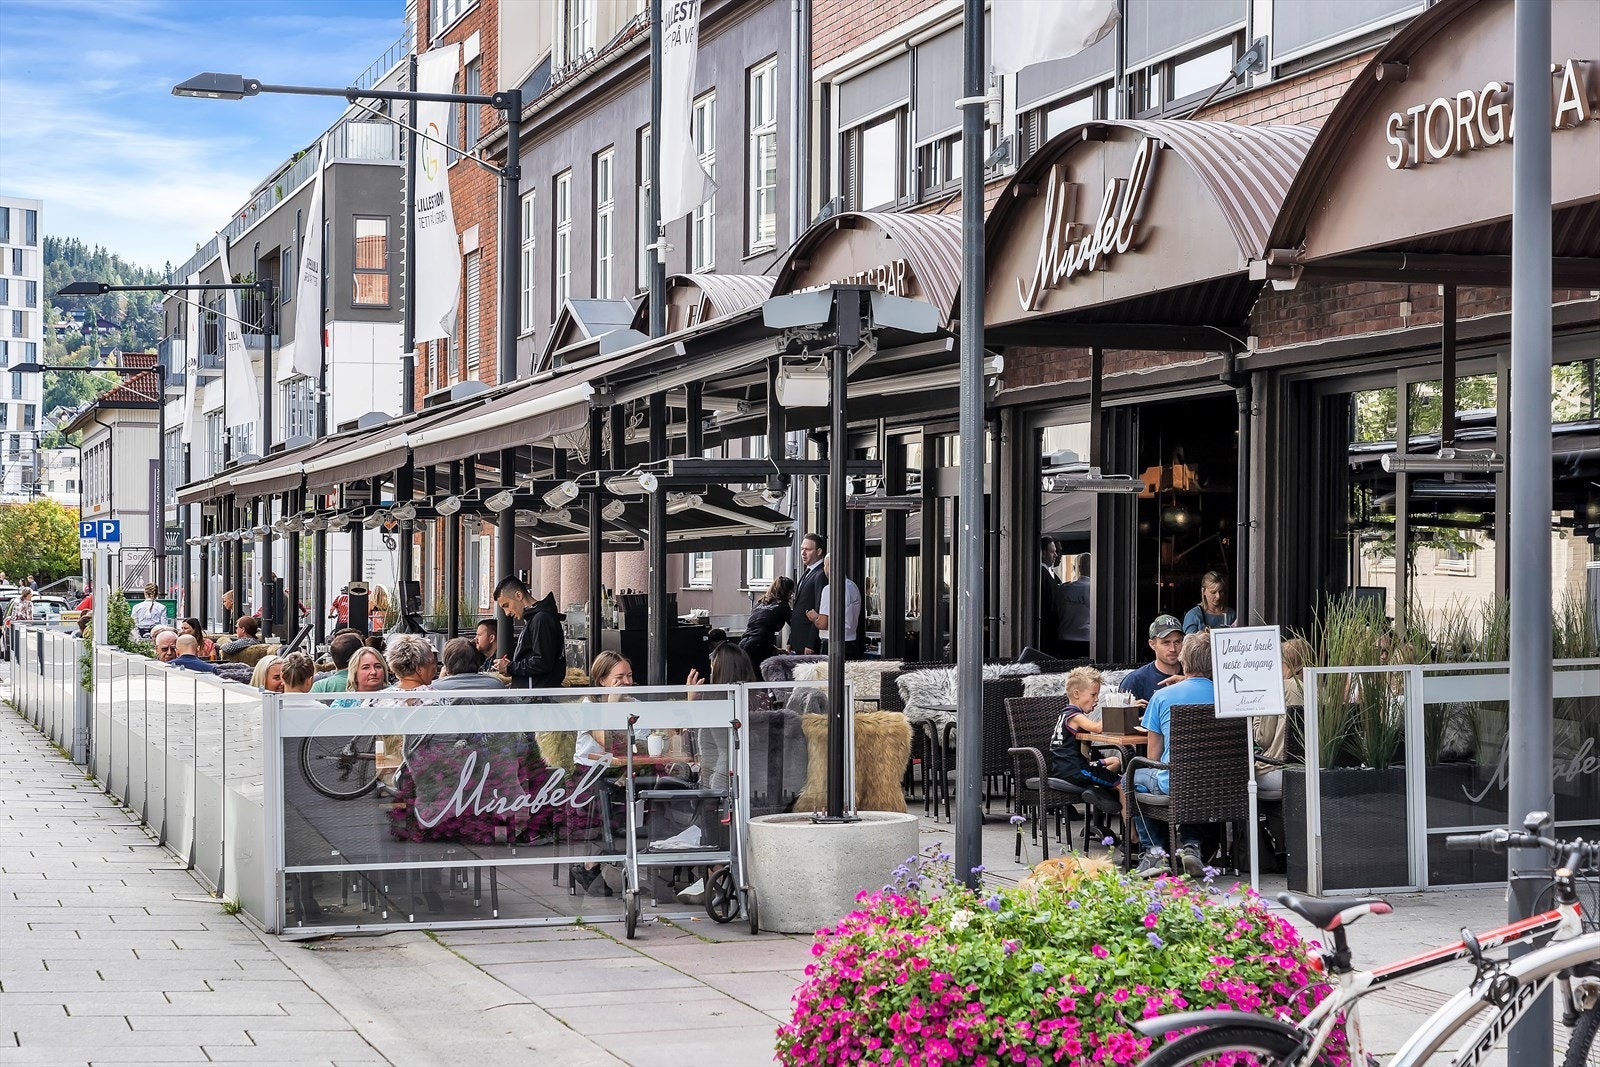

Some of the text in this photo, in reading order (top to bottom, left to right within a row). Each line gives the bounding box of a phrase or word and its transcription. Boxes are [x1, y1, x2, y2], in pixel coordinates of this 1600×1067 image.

[1386, 58, 1585, 170] STORGA
[1016, 136, 1150, 312] Mirabel
[83, 523, 93, 537] P
[102, 522, 115, 540] P
[1222, 659, 1242, 670] neste
[414, 750, 614, 828] Mirabel
